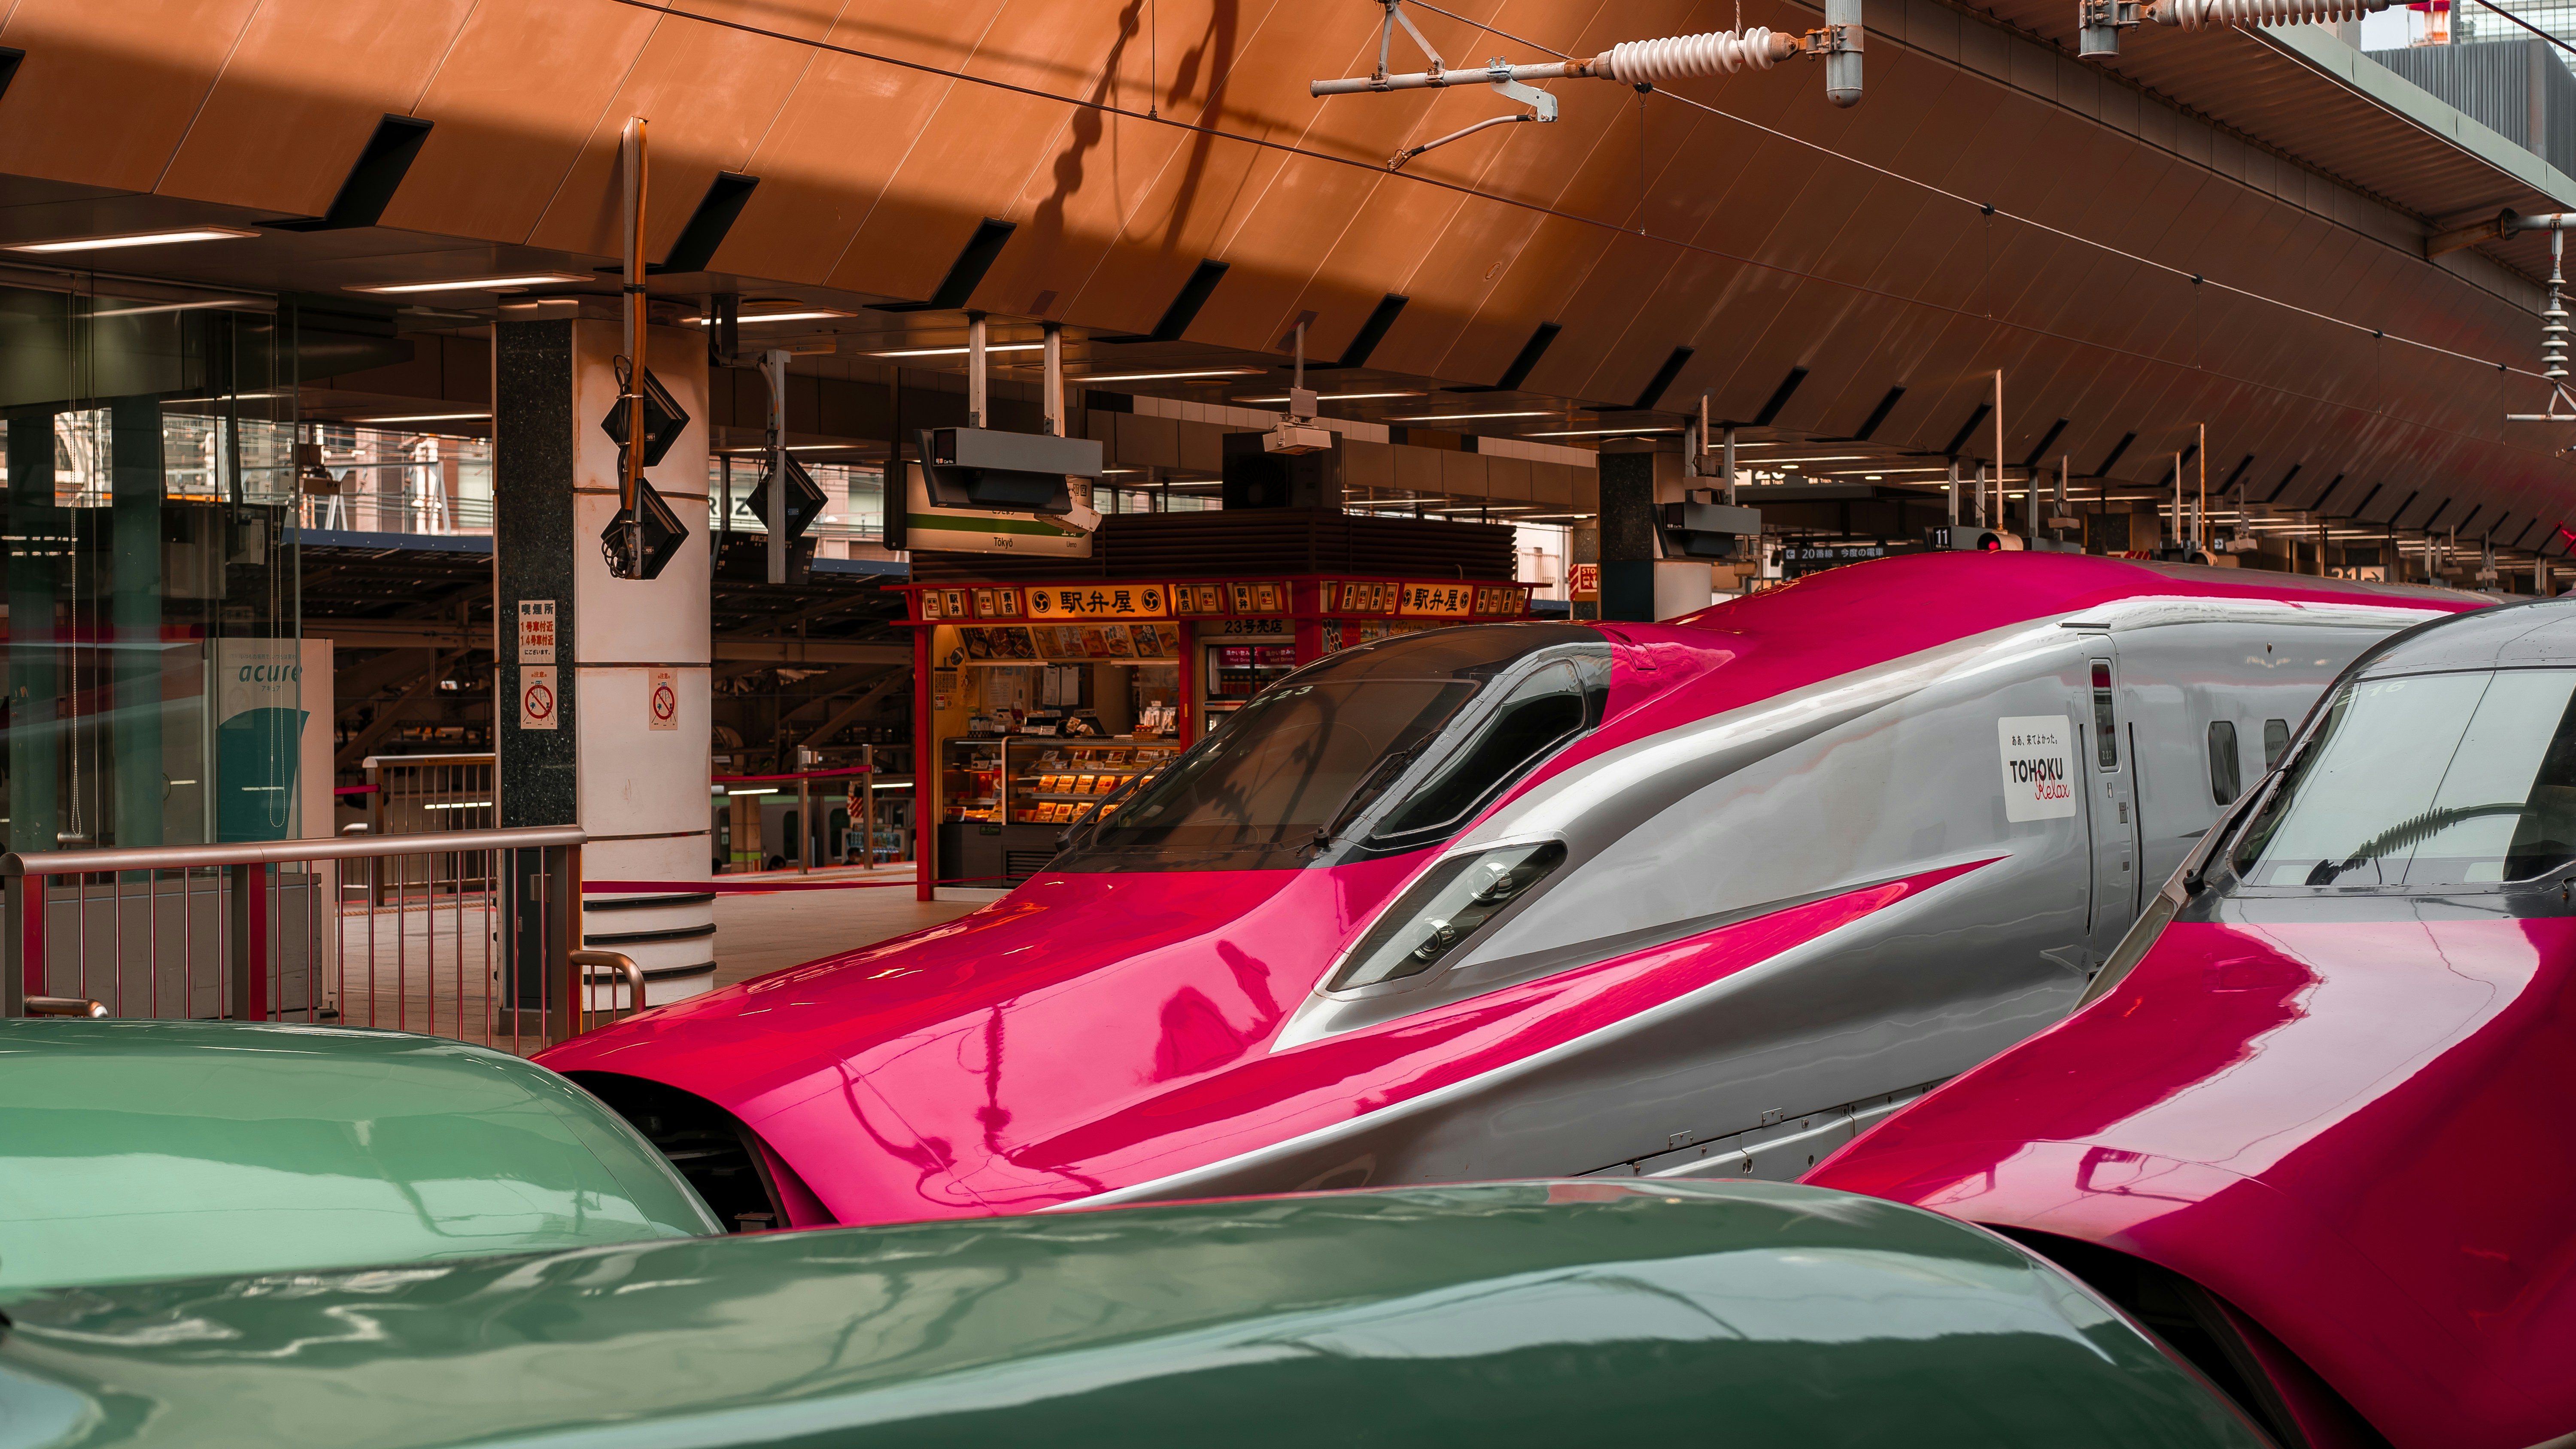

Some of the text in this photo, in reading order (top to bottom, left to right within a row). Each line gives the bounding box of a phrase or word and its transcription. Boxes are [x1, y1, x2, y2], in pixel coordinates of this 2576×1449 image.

[993, 537, 1013, 549] Tōkyō
[1936, 529, 1947, 545] 11
[1802, 547, 1884, 559] 20番線 今度の電車
[949, 594, 960, 614] 駅弁
[1003, 592, 1014, 613] 東京
[1060, 590, 1135, 613] 駅弁屋
[1179, 589, 1191, 610] 東京
[1236, 588, 1248, 609] 駅弁
[1344, 586, 1353, 608] 東京
[1372, 587, 1381, 609] 駅弁
[1413, 588, 1458, 612] 駅弁屋
[1477, 590, 1487, 611] 駅弁
[1503, 591, 1511, 612] 東京
[521, 603, 554, 615] 喫煙所
[520, 621, 553, 632] 1号車付近
[1224, 618, 1283, 634] 23号売店
[520, 634, 554, 646] 14号車付近
[239, 665, 302, 682] acure
[2012, 733, 2058, 746] ああ、来てよかった。
[2010, 758, 2063, 783] TOHOKU
[2035, 770, 2070, 800] Relax
